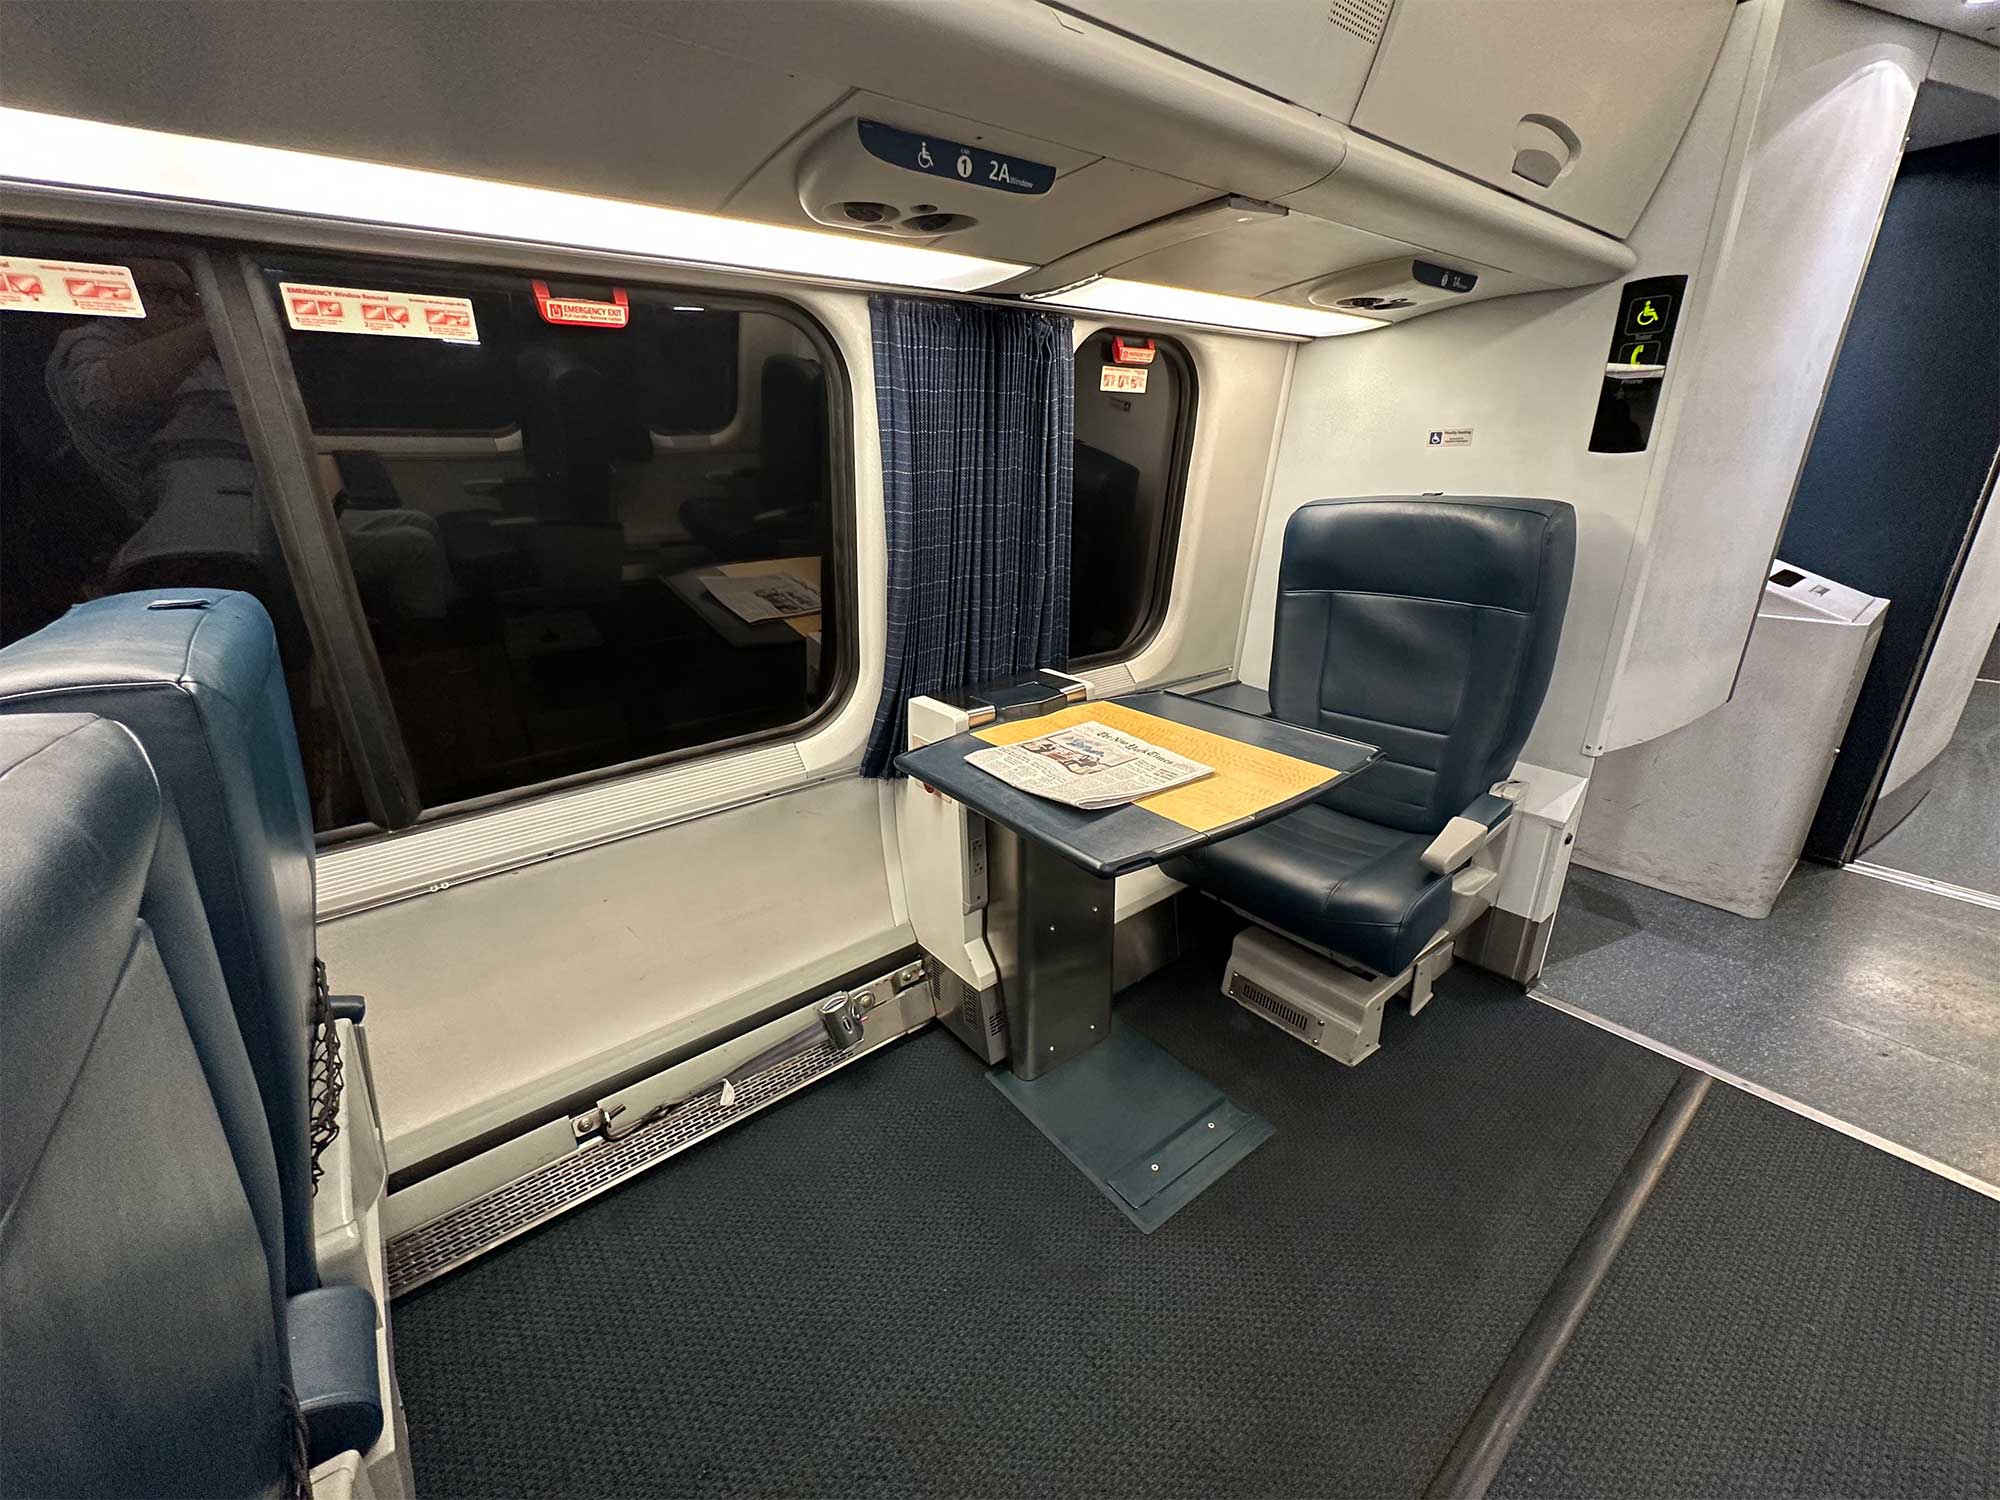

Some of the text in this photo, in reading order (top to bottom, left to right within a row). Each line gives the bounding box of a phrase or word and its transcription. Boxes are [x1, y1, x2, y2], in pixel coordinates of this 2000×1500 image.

[988, 160, 1010, 183] 2A
[1010, 176, 1033, 188] Window
[287, 287, 389, 301] EMERGENCY Window Removal
[564, 305, 606, 315] EMERGENCY
[1147, 751, 1174, 765] Times
